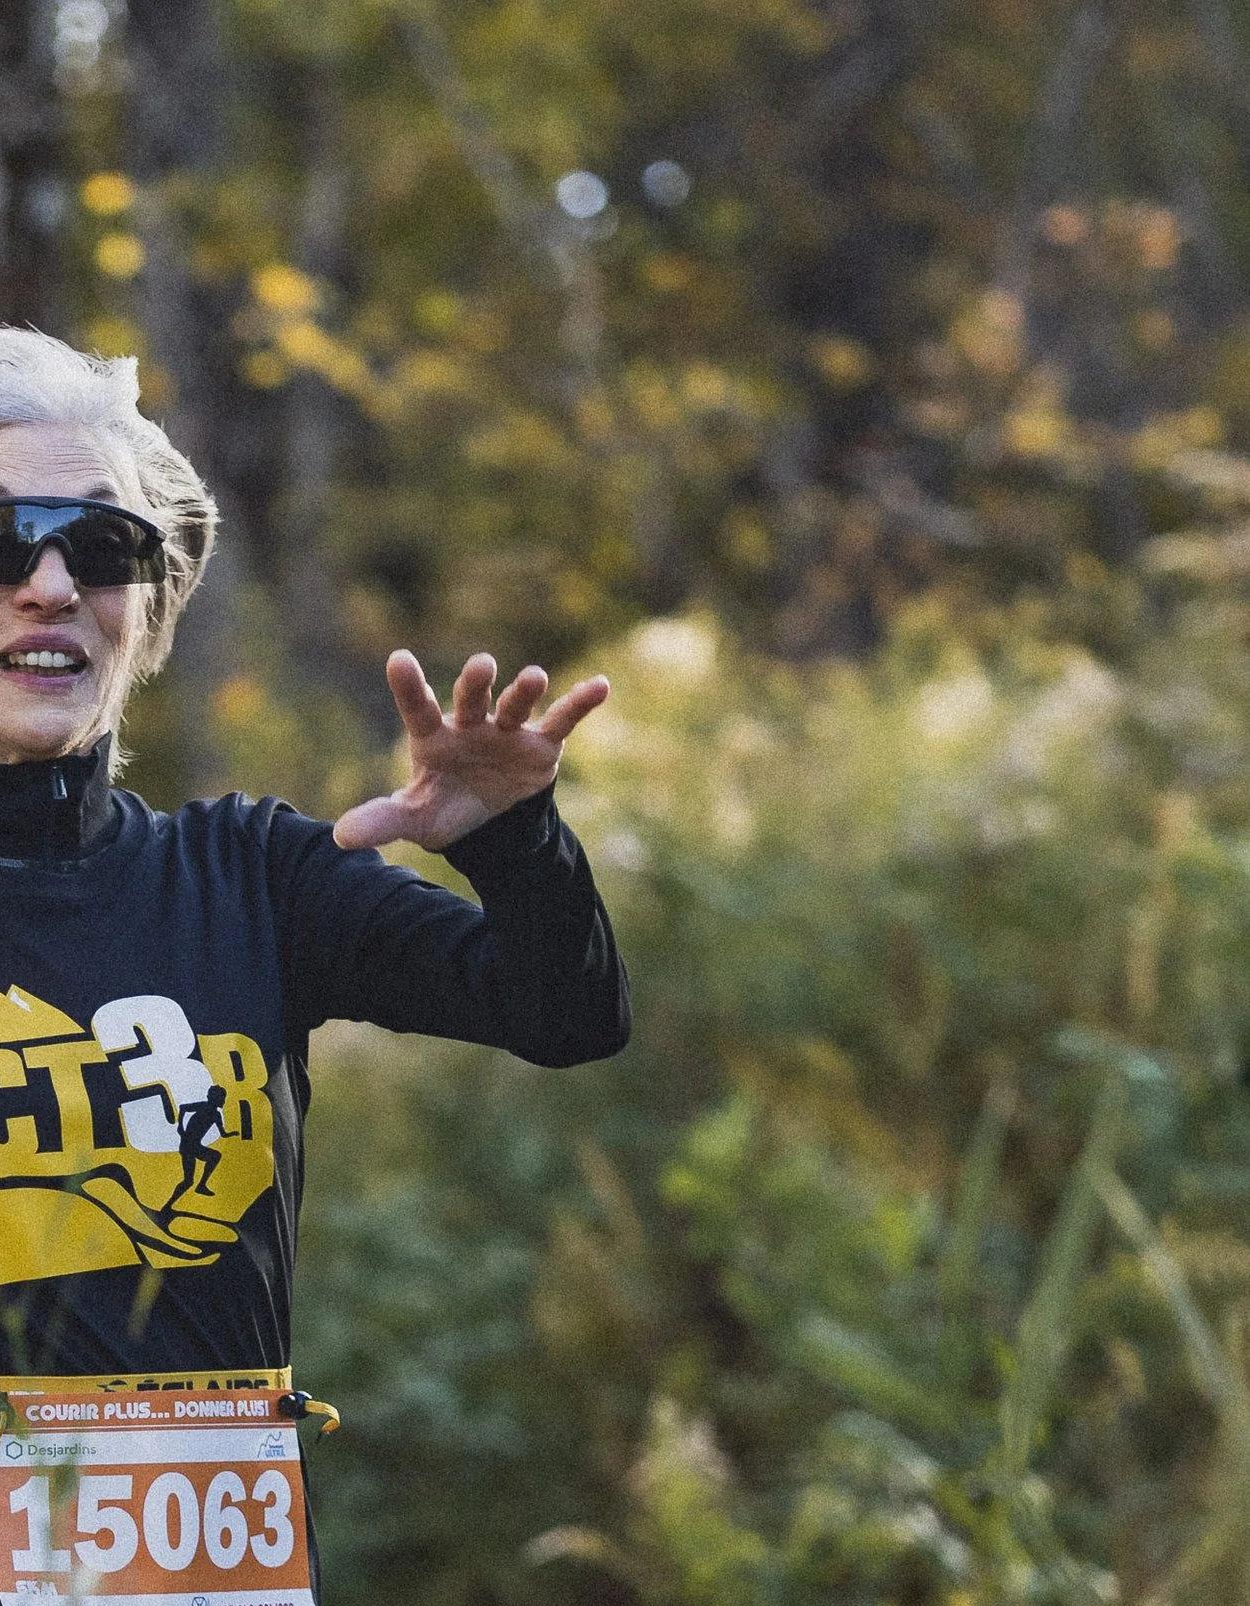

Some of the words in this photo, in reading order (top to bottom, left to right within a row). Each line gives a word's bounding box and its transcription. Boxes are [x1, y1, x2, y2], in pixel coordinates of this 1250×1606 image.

[25, 1402, 99, 1422] COURIR
[174, 1401, 236, 1418] DONNER
[237, 1399, 270, 1417] PLUS!
[27, 1443, 97, 1458] Desjardins
[9, 1468, 295, 1574] 15063
